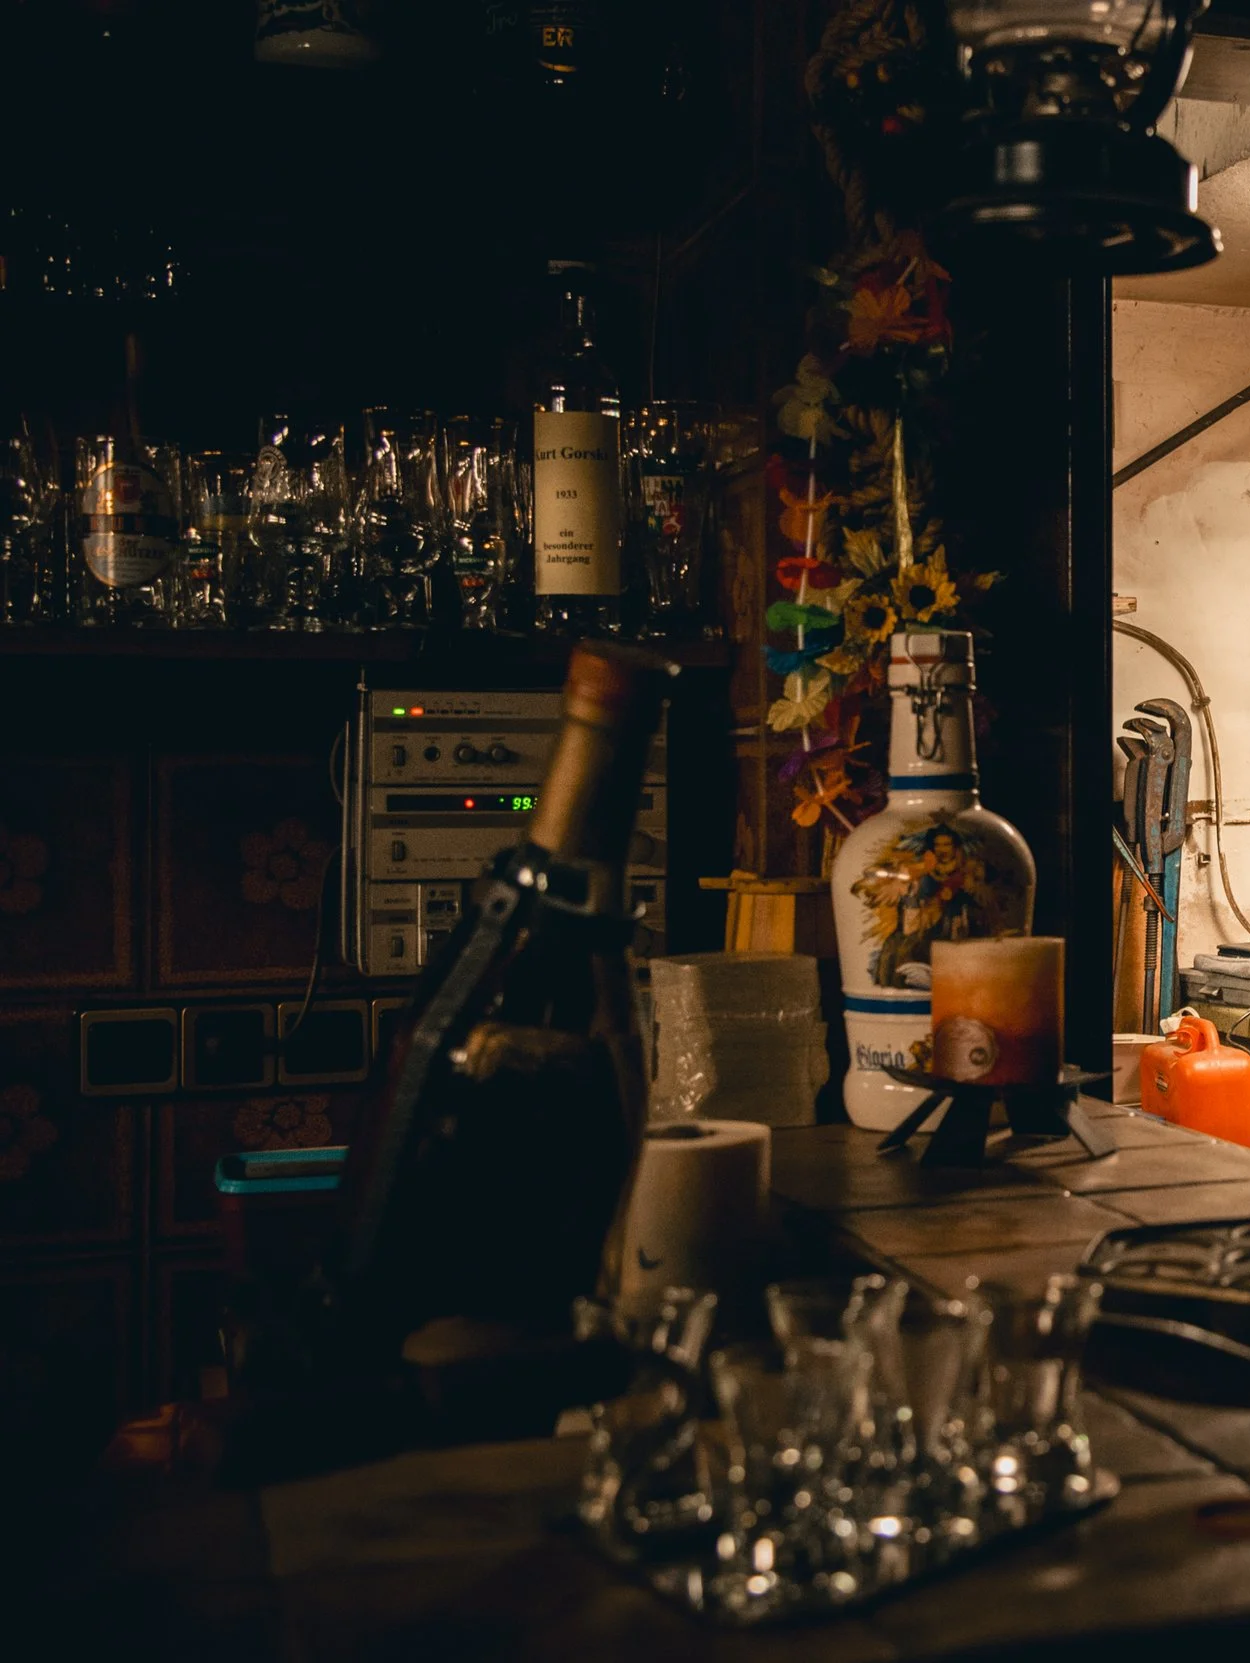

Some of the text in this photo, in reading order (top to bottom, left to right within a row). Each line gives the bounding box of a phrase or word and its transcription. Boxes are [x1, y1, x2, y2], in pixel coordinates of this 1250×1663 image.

[556, 490, 578, 500] 1933
[559, 528, 574, 538] ein
[543, 541, 594, 551] besonderer
[546, 554, 592, 565] Jahrgang
[512, 796, 538, 811] 99.
